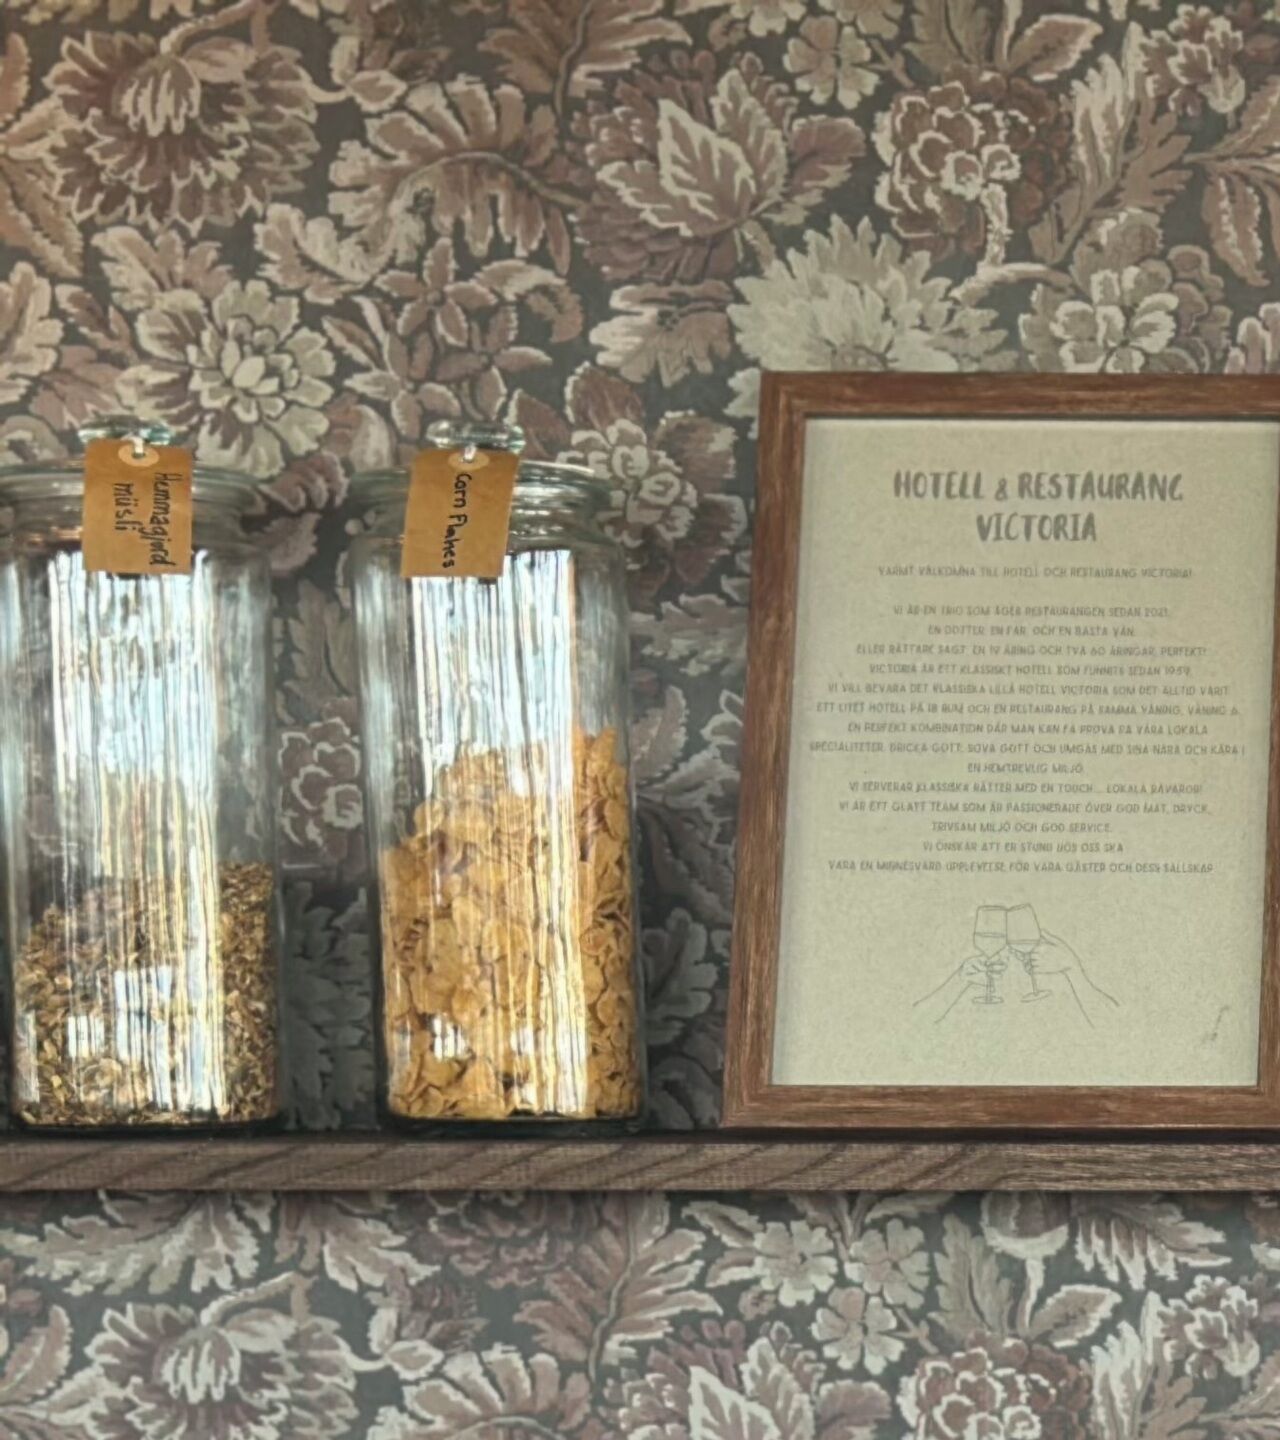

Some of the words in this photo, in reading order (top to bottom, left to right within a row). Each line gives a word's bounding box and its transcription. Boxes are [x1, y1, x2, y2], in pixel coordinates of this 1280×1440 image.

[453, 474, 473, 508] Corn
[894, 471, 985, 501] HOTELL
[994, 482, 1009, 501] &
[1018, 471, 1183, 502] RESTAURANG
[113, 483, 142, 531] müsli
[139, 472, 182, 566] Hemmagjord
[976, 512, 1098, 541] VICTORIA
